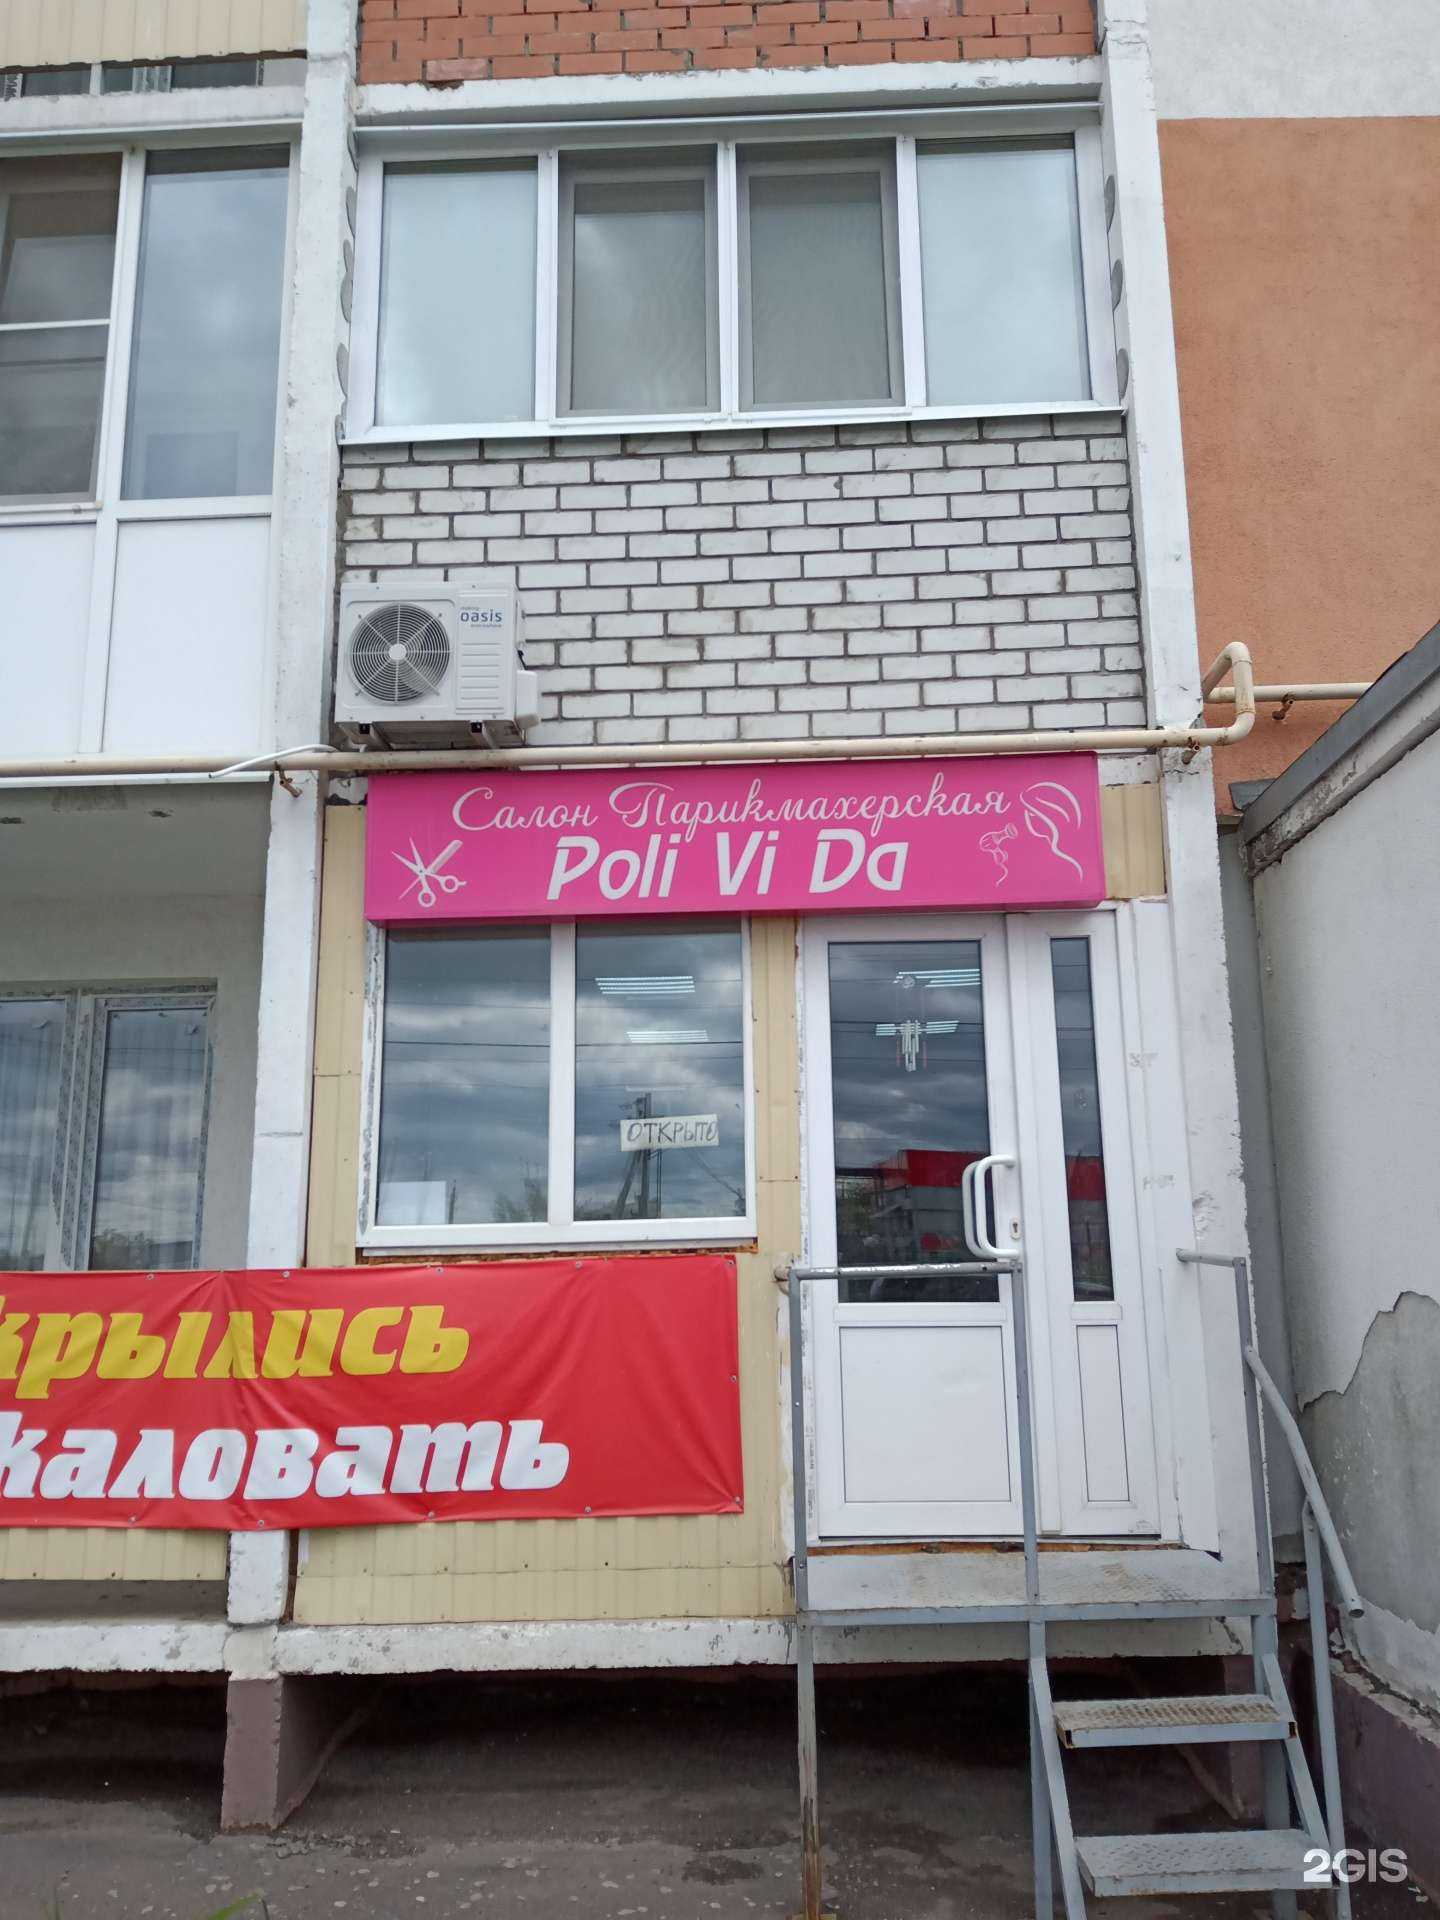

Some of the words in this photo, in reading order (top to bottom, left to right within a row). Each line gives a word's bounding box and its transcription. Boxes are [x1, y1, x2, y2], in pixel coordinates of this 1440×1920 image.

[460, 608, 502, 622] oasis
[452, 786, 599, 831] Салон
[608, 772, 1010, 843] Парикмахерская
[546, 832, 681, 901] Poli
[716, 830, 779, 896] Vi
[809, 828, 909, 894] Da
[626, 1121, 718, 1144] ОТКРЫТО
